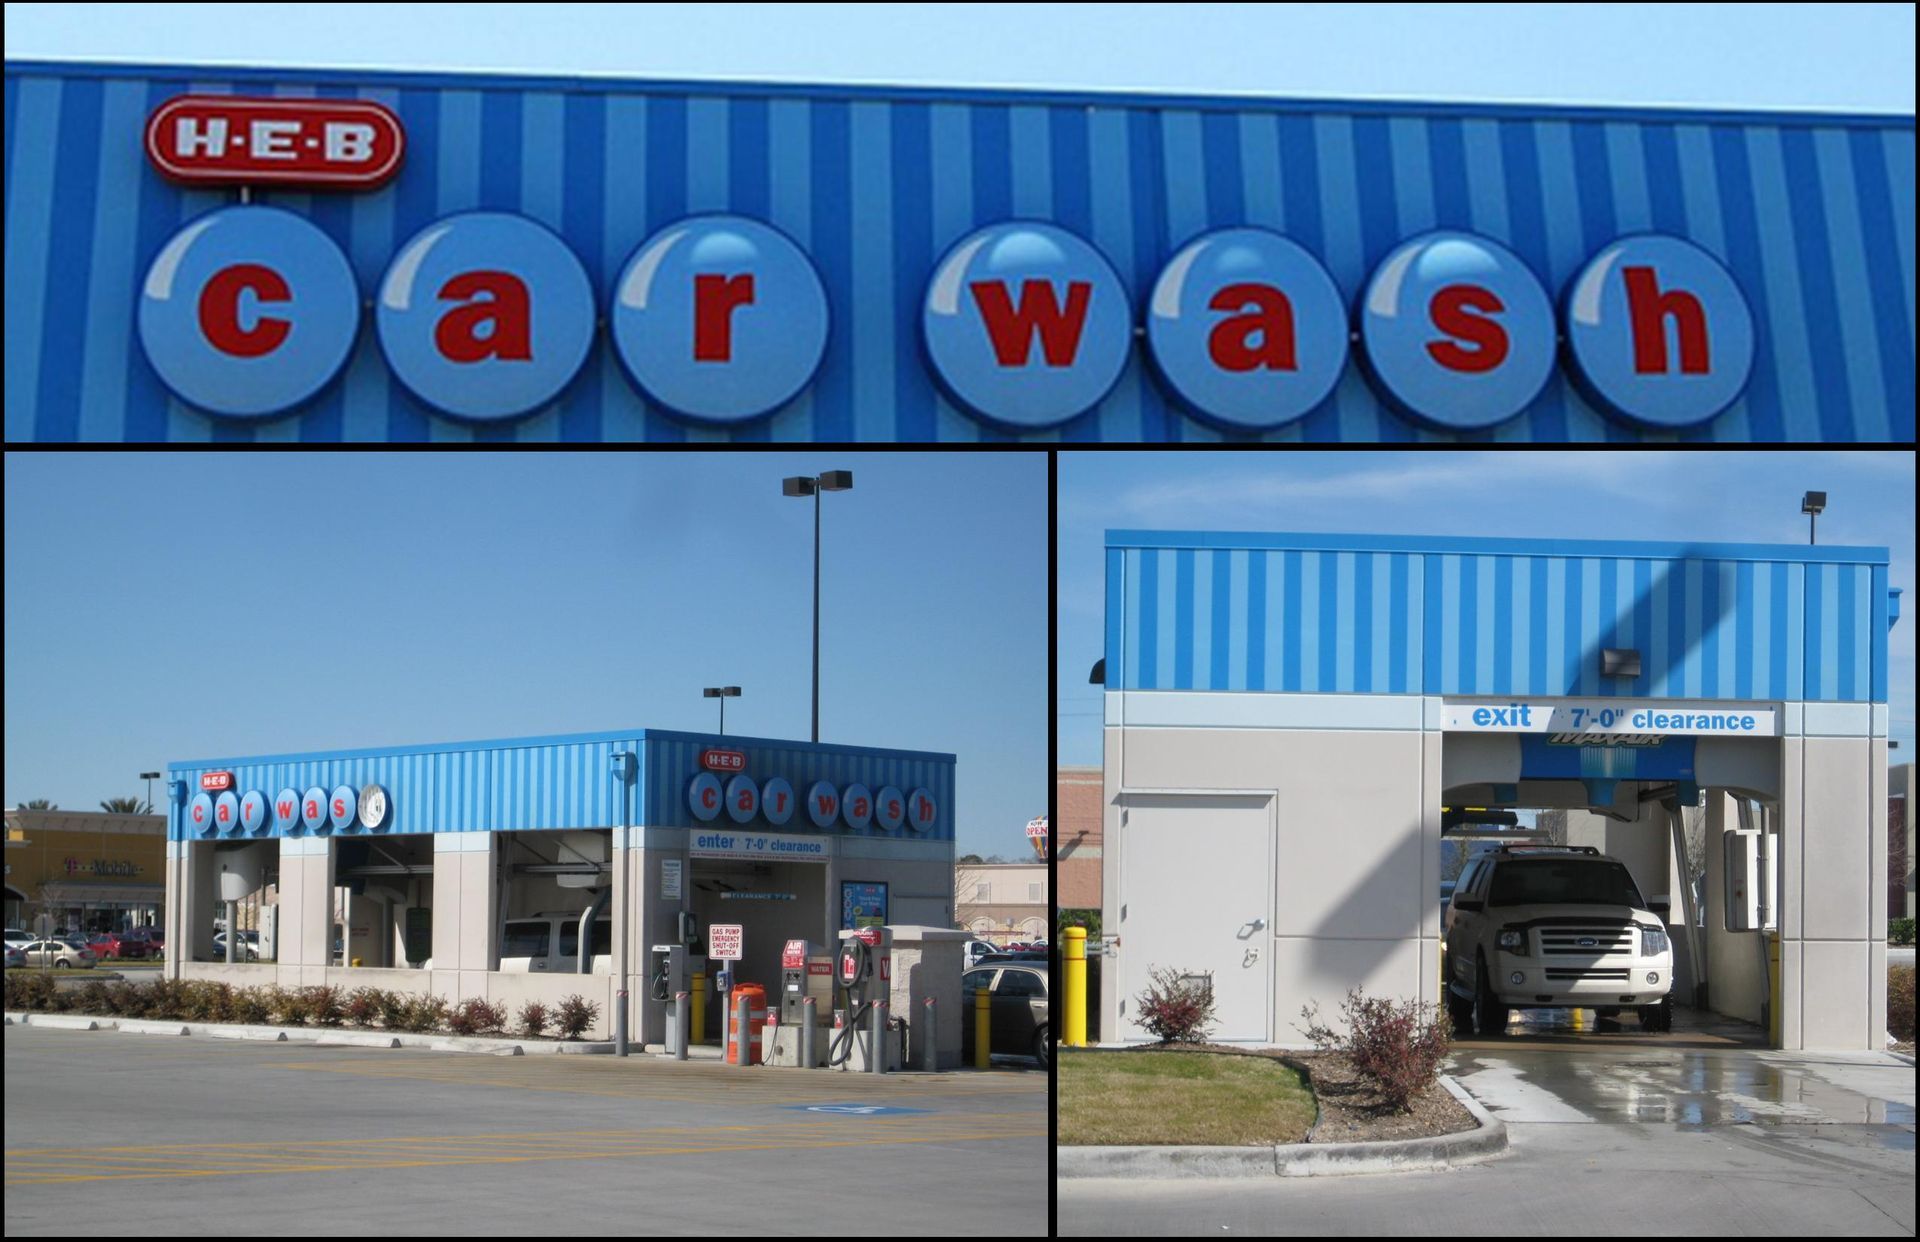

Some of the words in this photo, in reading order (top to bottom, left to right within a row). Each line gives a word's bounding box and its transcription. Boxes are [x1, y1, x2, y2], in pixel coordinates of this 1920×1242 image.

[197, 263, 755, 364] car
[970, 265, 1711, 376] wash
[1472, 703, 1531, 727] exit
[1632, 711, 1756, 731] clearance
[193, 801, 252, 823] car
[702, 788, 787, 812] car
[818, 794, 933, 822] wash
[697, 834, 735, 850] enter
[770, 840, 821, 853] clearance
